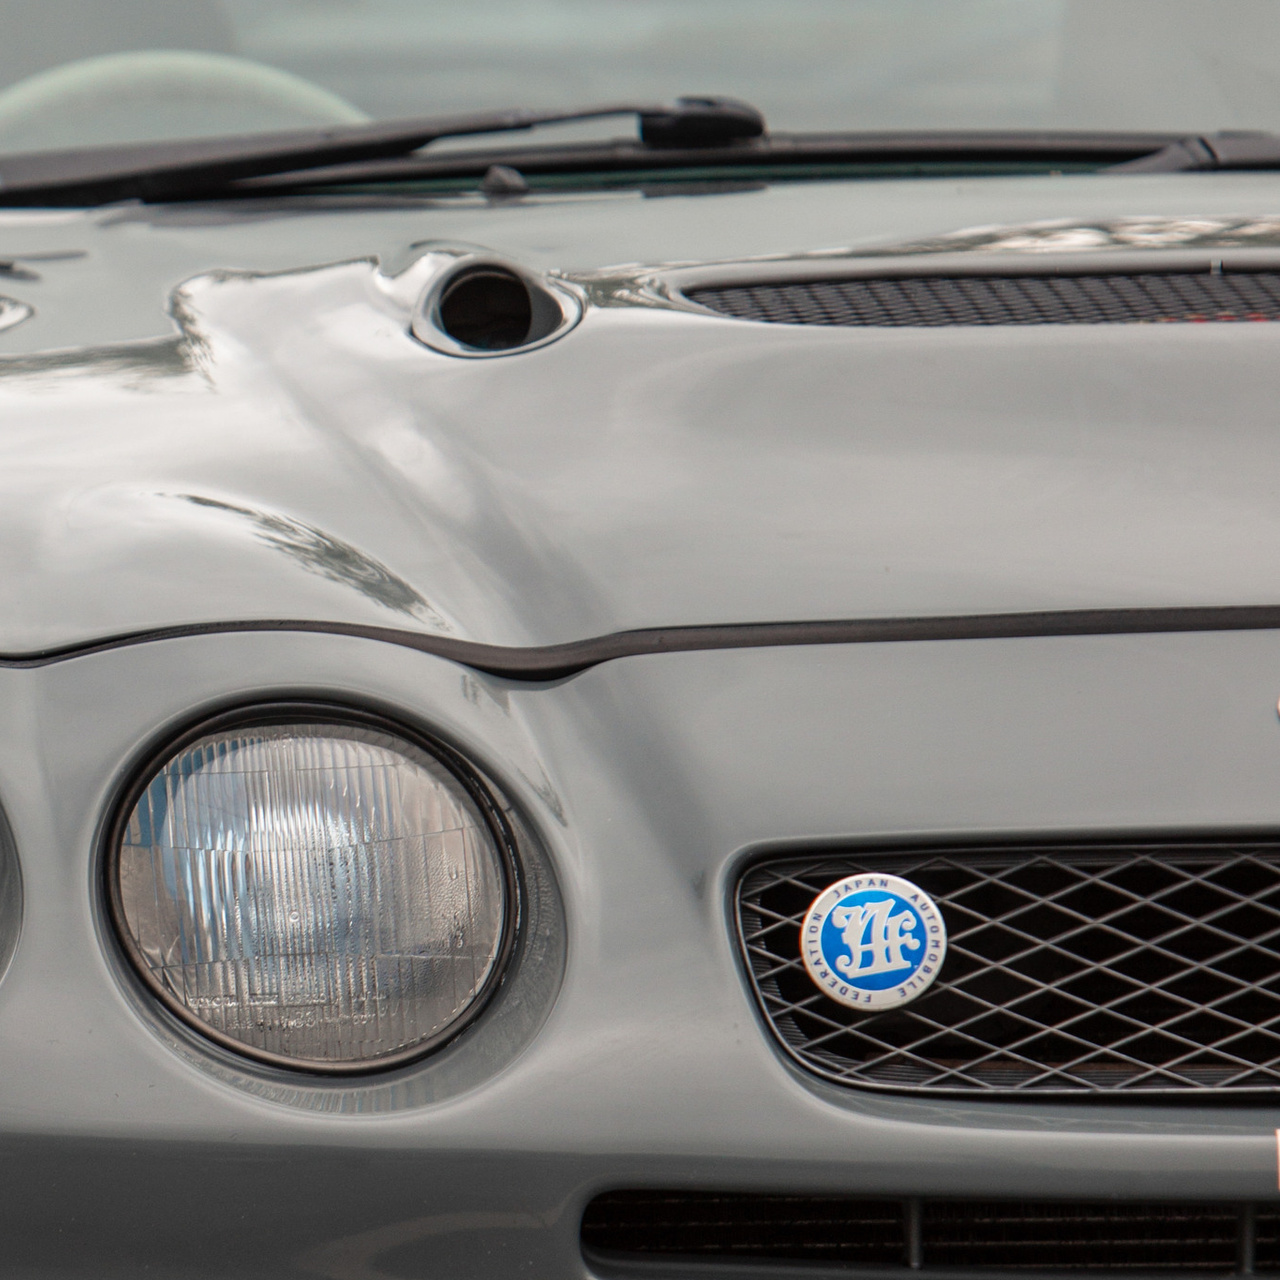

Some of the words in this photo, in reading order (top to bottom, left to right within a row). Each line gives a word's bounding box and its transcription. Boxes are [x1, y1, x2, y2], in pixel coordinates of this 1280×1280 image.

[833, 878, 890, 899] JAPAN
[808, 912, 873, 1004] FEDERATION
[897, 892, 942, 998] AUTOMOBILE
